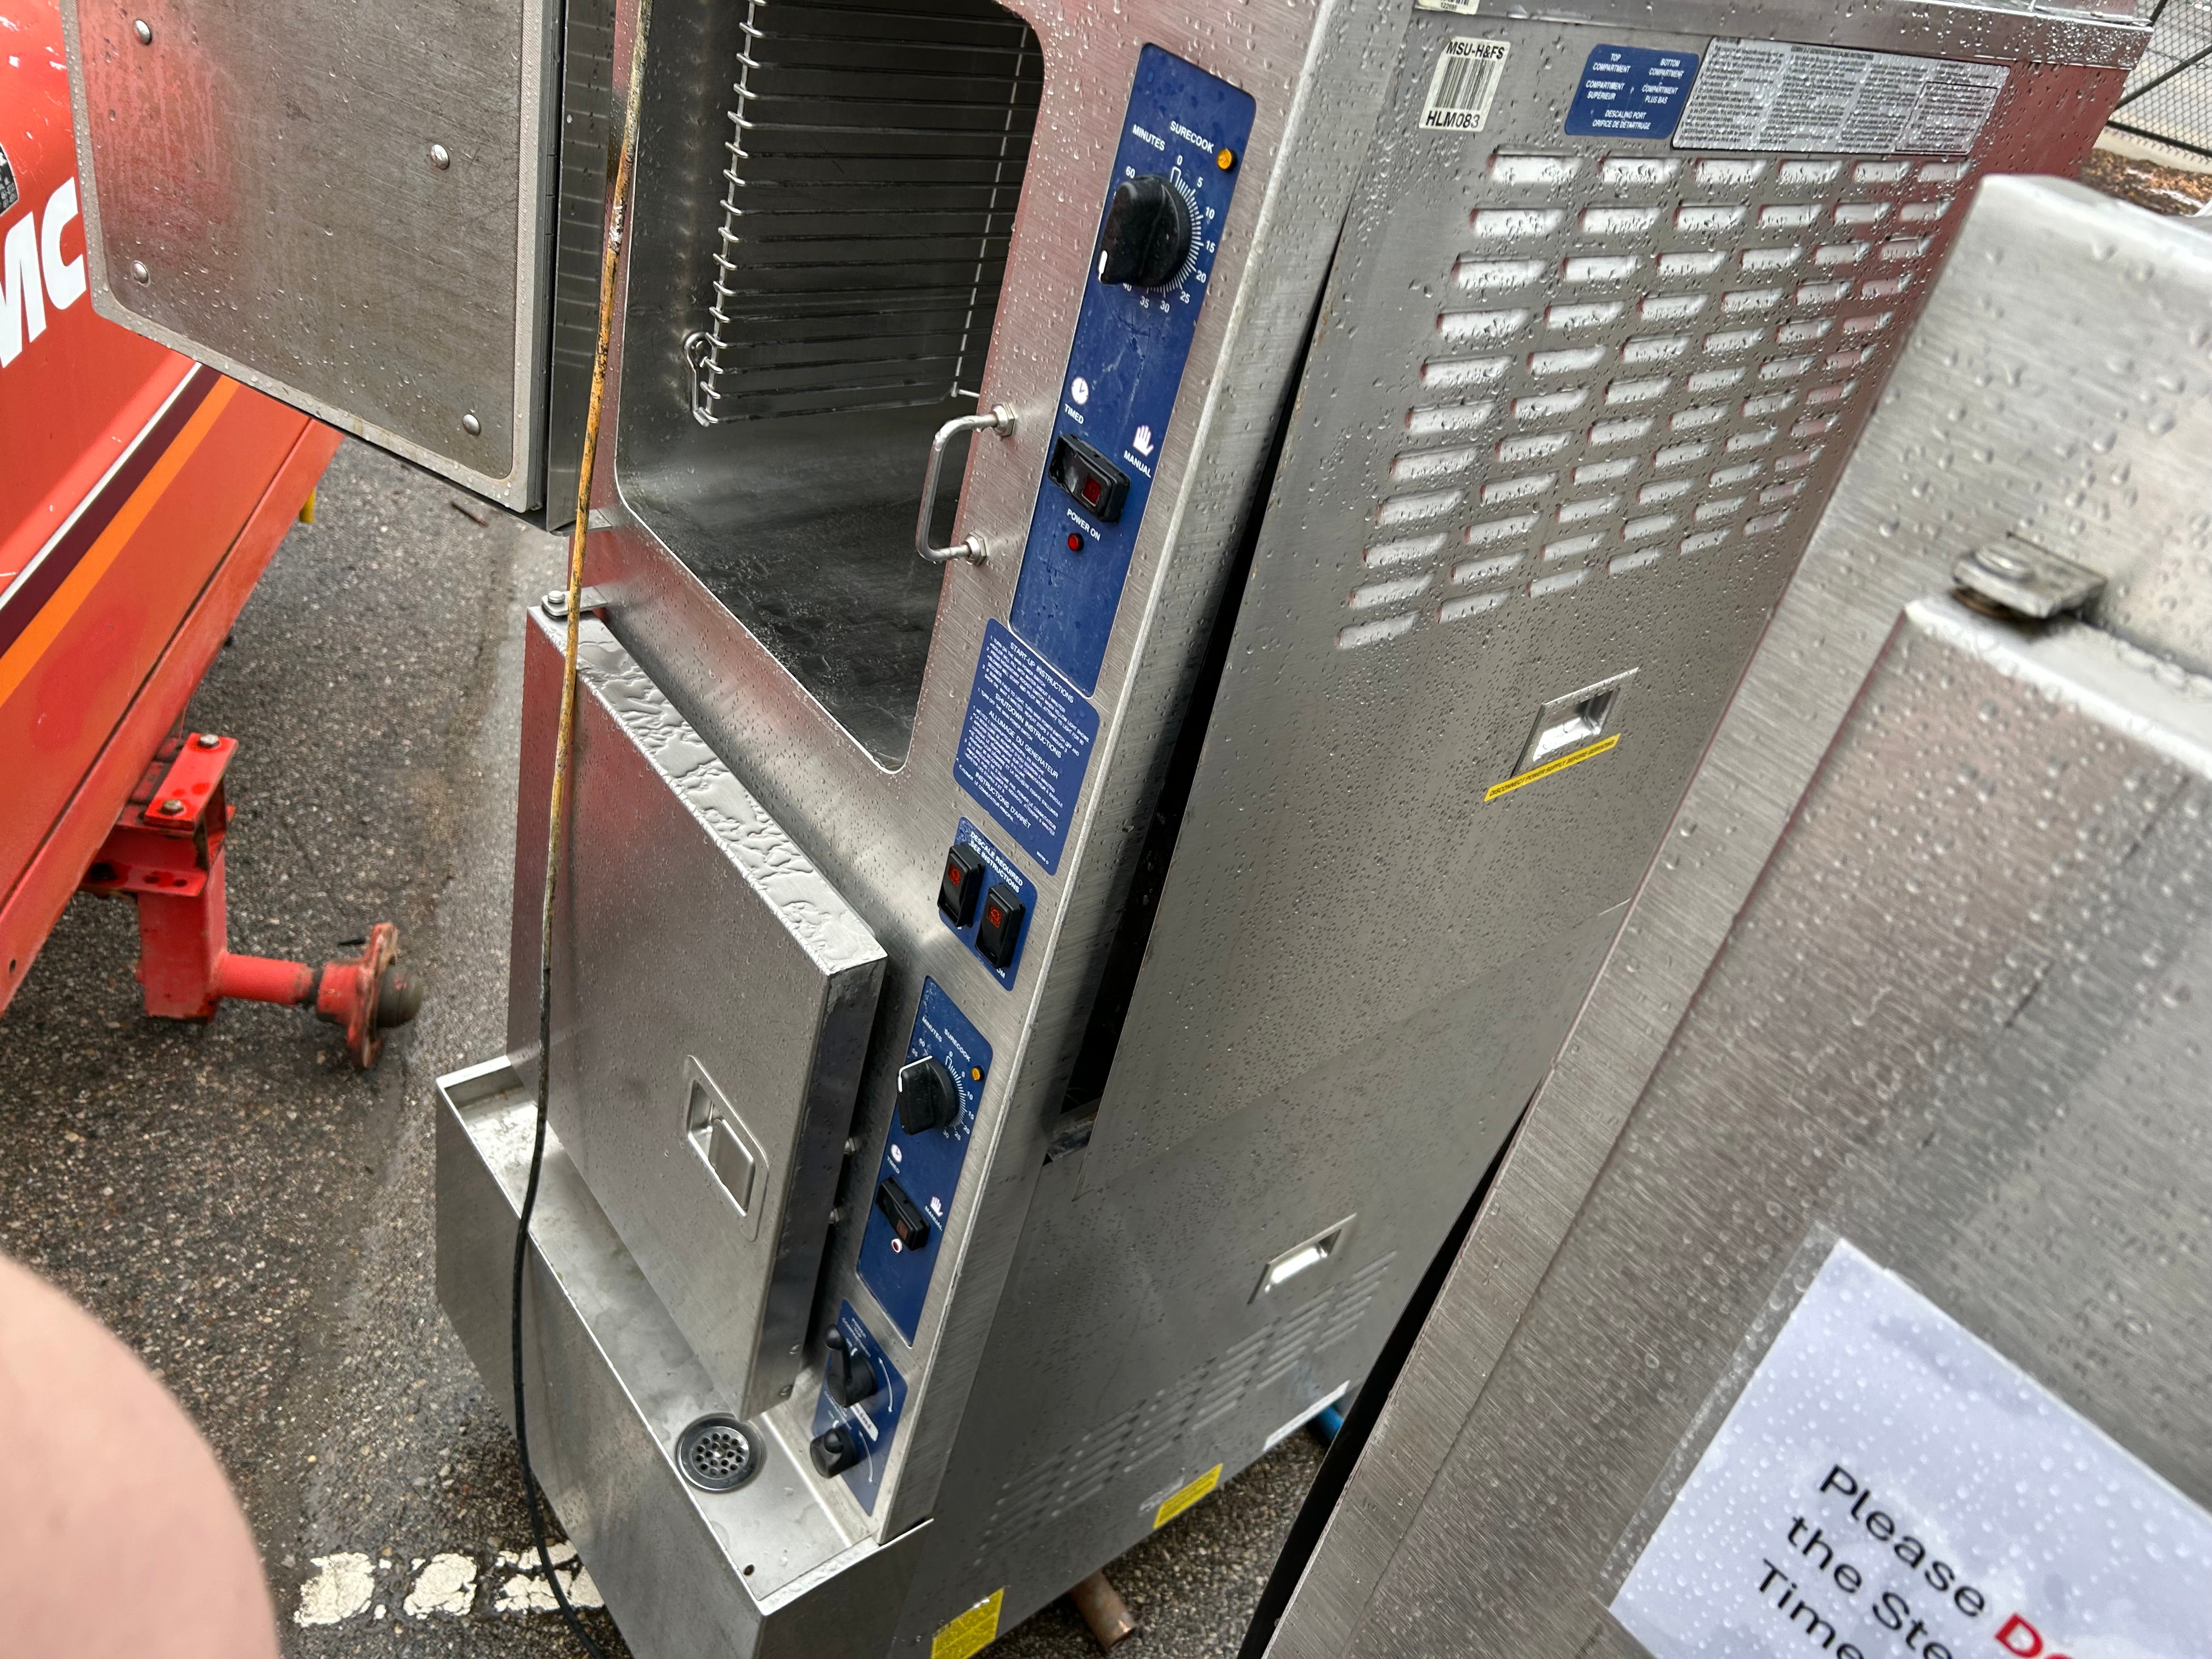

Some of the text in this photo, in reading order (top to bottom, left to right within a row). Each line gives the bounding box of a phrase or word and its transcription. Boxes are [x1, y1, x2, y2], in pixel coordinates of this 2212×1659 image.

[1446, 42, 1505, 60] MSU-H&FS
[1593, 63, 1630, 73] COMPARTMENT
[1660, 58, 1680, 67] BOTTOM
[1649, 68, 1684, 78] COMPARTMENT
[1645, 95, 1657, 104] PLUS
[1426, 111, 1480, 128] HLM083
[1605, 110, 1633, 119] DESCALING
[1132, 124, 1165, 151] MINUTES
[1170, 121, 1215, 154] SURECOOK
[1177, 155, 1183, 166] 0
[1126, 166, 1136, 179] 60
[1197, 177, 1203, 188] 5
[1205, 206, 1215, 219] 10
[1206, 240, 1216, 253] 15
[1196, 270, 1206, 283] 20
[1140, 296, 1149, 308] 35
[1180, 291, 1190, 304] 25
[1160, 301, 1170, 313] 30
[1065, 404, 1084, 425] TIMED
[1124, 450, 1152, 478] MANUAL
[1066, 508, 1101, 542] POWER ON
[1009, 641, 1074, 703] START-UP INSTRUCTIONS
[995, 692, 1024, 724] SHUTDOWN
[1024, 720, 1062, 759] INSTRUCTIONS
[988, 709, 1015, 738] ALLUMAGE
[1015, 735, 1024, 747] DU
[1024, 743, 1058, 780] GENERATEUR
[975, 769, 1009, 809] INSTRUCTIONS
[1010, 804, 1031, 830] D'ARRÊT
[970, 831, 995, 859] DESCALE
[996, 856, 1023, 887] REQUIRED
[970, 840, 981, 854] SEE
[981, 851, 1019, 893] INSTRUCTIONS
[922, 1016, 943, 1042] MINUTES
[944, 1028, 971, 1062] SURECOOK
[967, 1091, 973, 1100] 10
[968, 1111, 974, 1120] 15
[963, 1125, 970, 1135] 20
[1787, 1515, 1863, 1594] the
[1819, 1464, 2074, 1659] Please D
